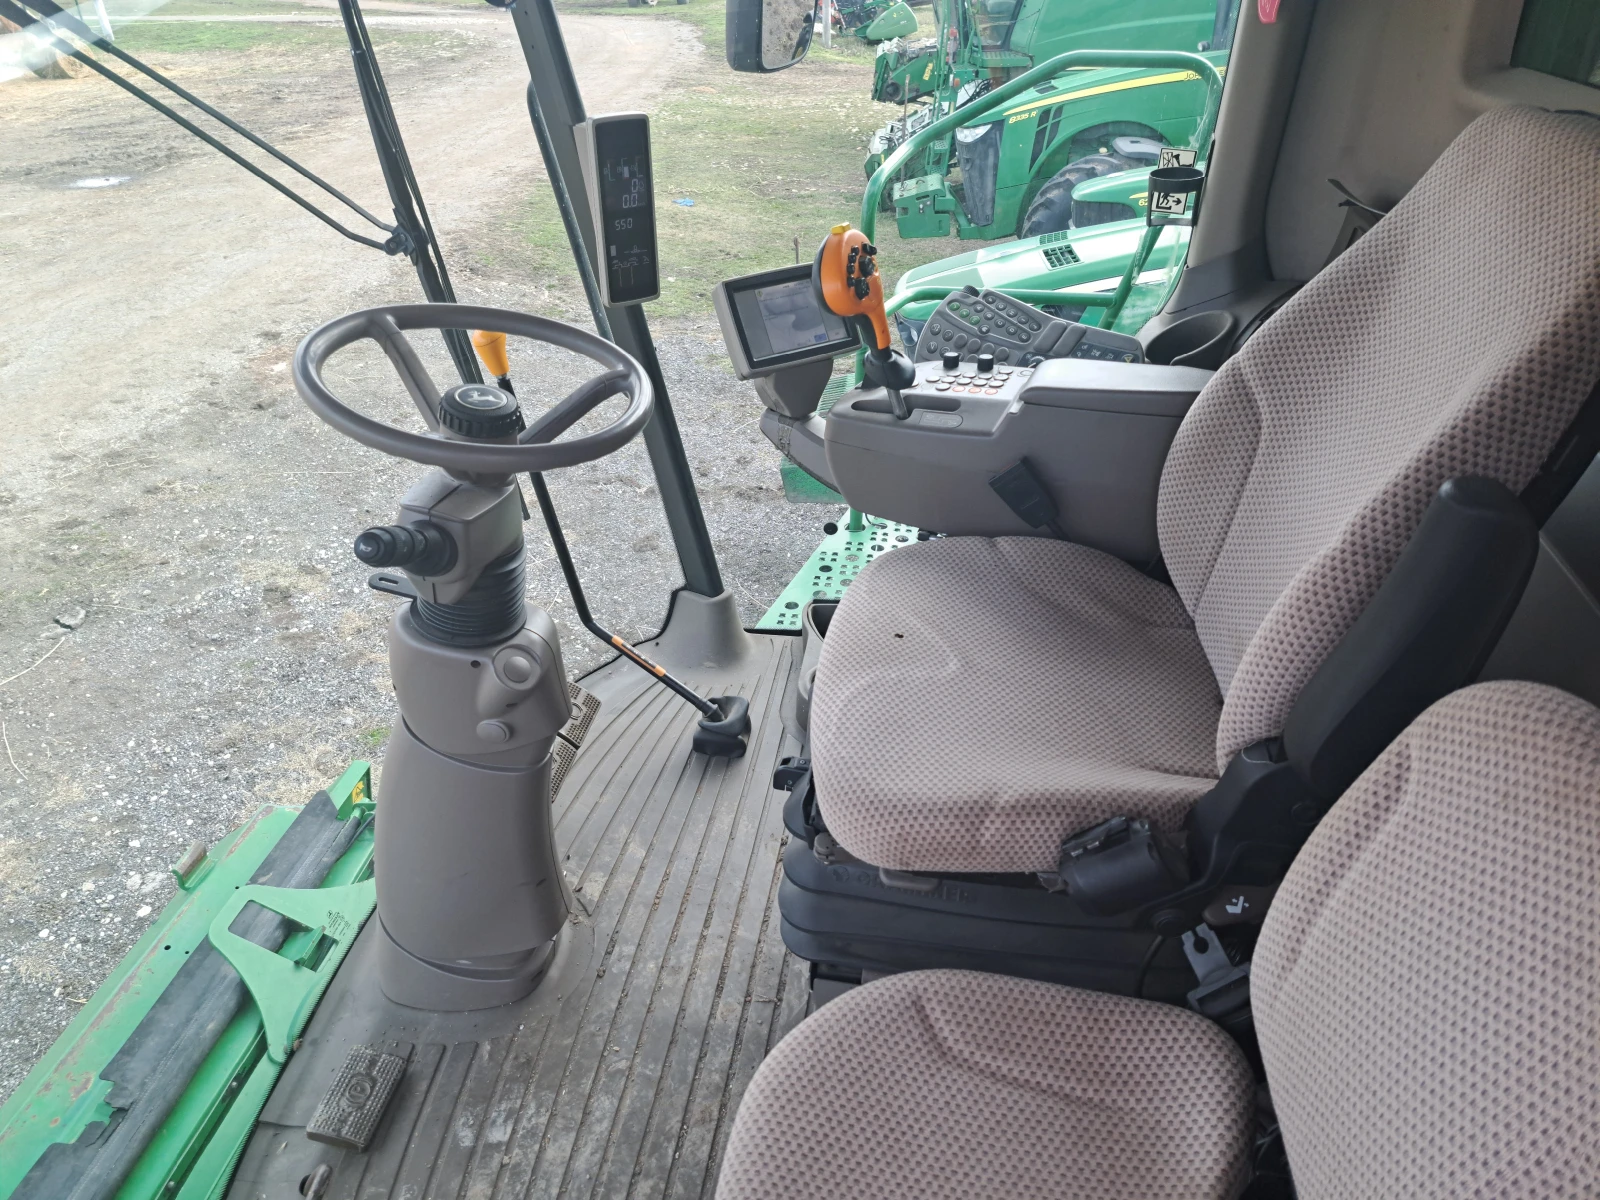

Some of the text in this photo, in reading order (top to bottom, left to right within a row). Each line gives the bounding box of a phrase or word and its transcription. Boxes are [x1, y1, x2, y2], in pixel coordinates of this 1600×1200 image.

[1008, 112, 1030, 124] 8335
[622, 193, 638, 208] 0.0
[614, 218, 632, 230] 550
